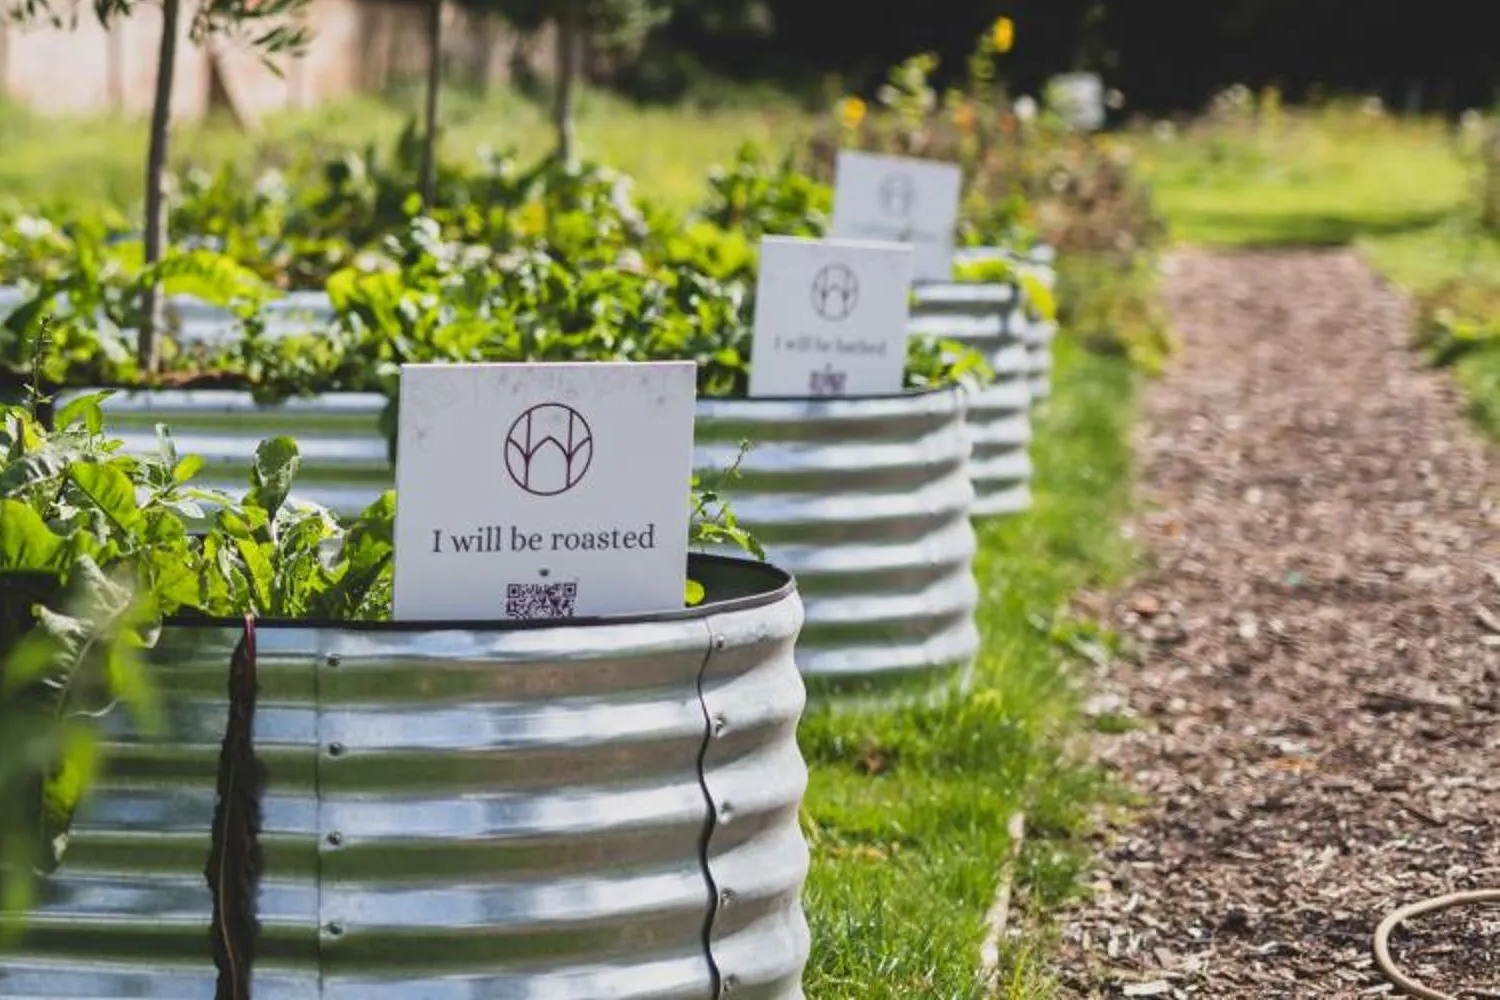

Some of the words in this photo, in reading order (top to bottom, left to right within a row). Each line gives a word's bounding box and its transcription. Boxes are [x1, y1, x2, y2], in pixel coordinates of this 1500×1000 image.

[432, 529, 442, 553] I
[450, 525, 501, 553] will
[511, 525, 543, 551] be
[551, 523, 655, 551] roasted
